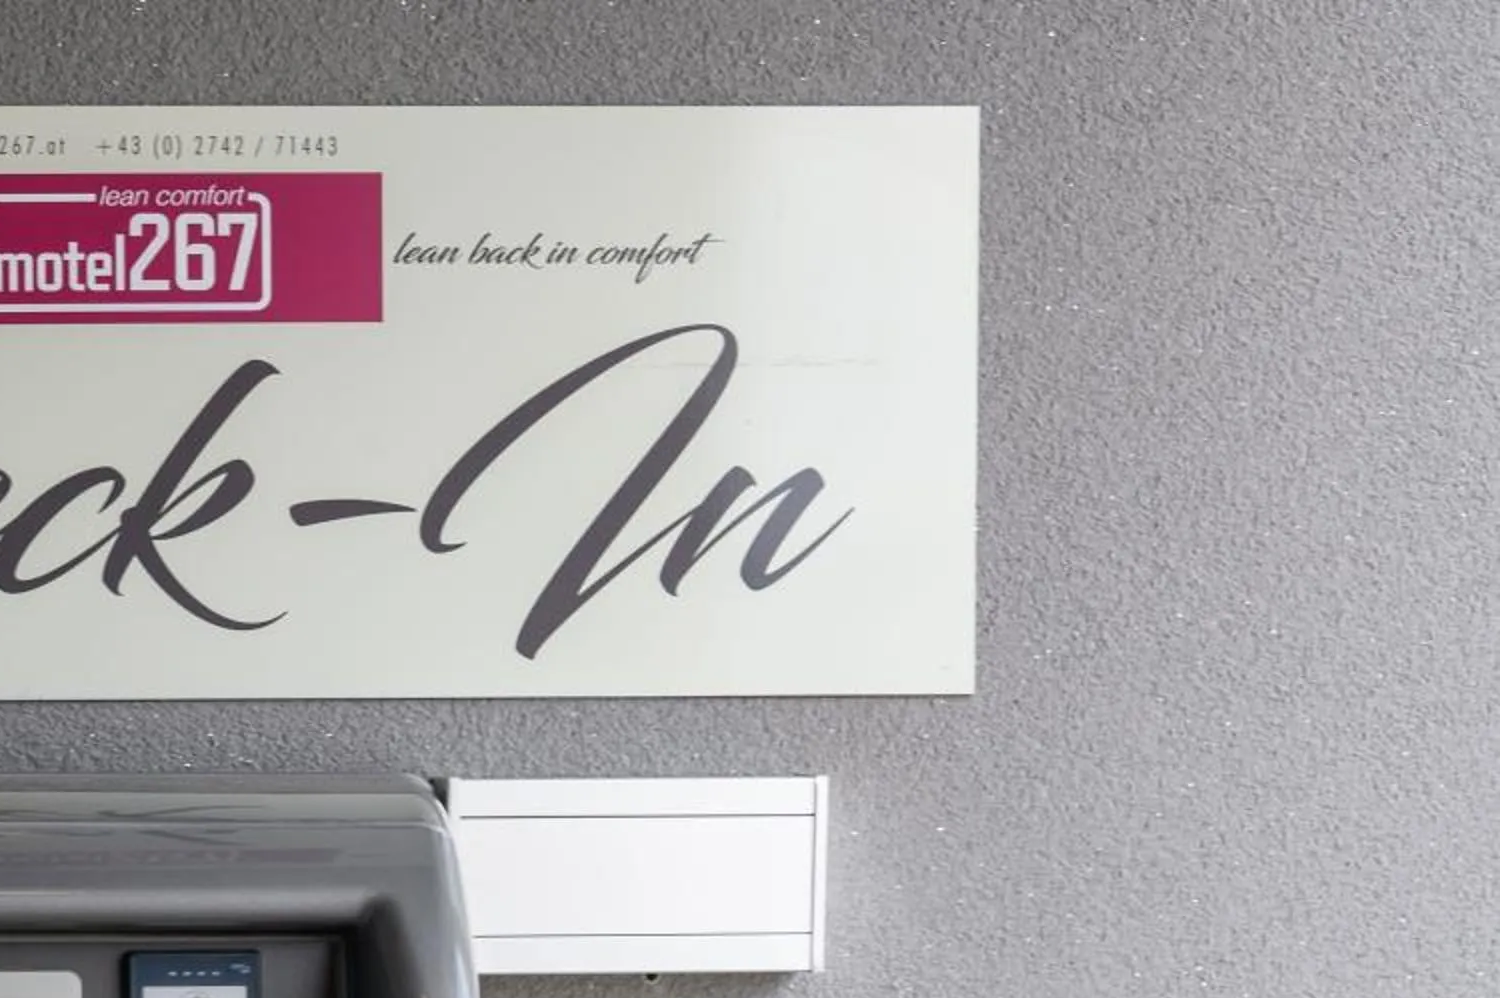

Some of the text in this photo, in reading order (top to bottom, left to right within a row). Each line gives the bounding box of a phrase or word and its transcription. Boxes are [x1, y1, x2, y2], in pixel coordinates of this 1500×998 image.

[96, 135, 143, 156] +43
[153, 135, 183, 160] (0)
[194, 135, 244, 156] 2742
[276, 135, 339, 156] 71443
[99, 184, 246, 207] lean comfort
[391, 231, 724, 285] lean back in comfort
